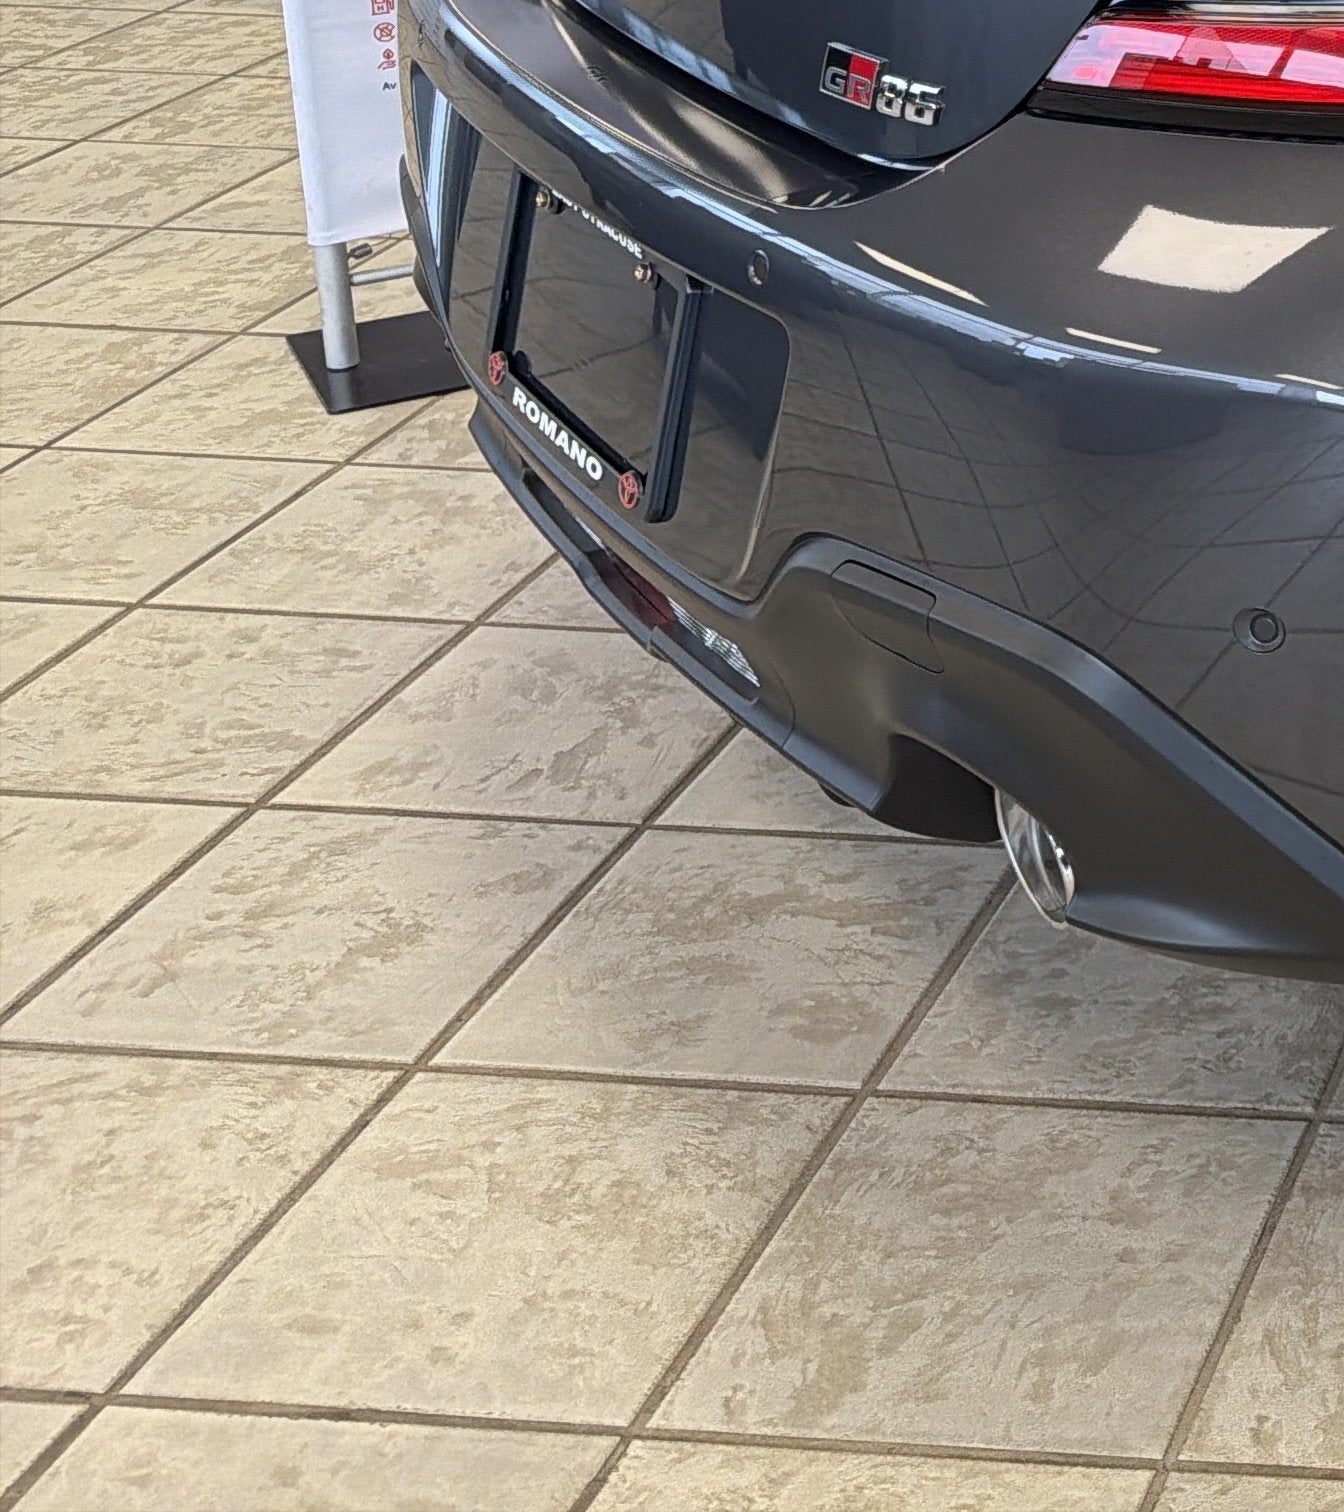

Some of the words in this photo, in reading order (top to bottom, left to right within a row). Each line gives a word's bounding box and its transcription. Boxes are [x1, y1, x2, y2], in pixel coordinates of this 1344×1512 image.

[382, 82, 396, 91] Av
[824, 66, 871, 104] GR
[875, 74, 946, 127] 86
[512, 386, 603, 481] ROMANO
